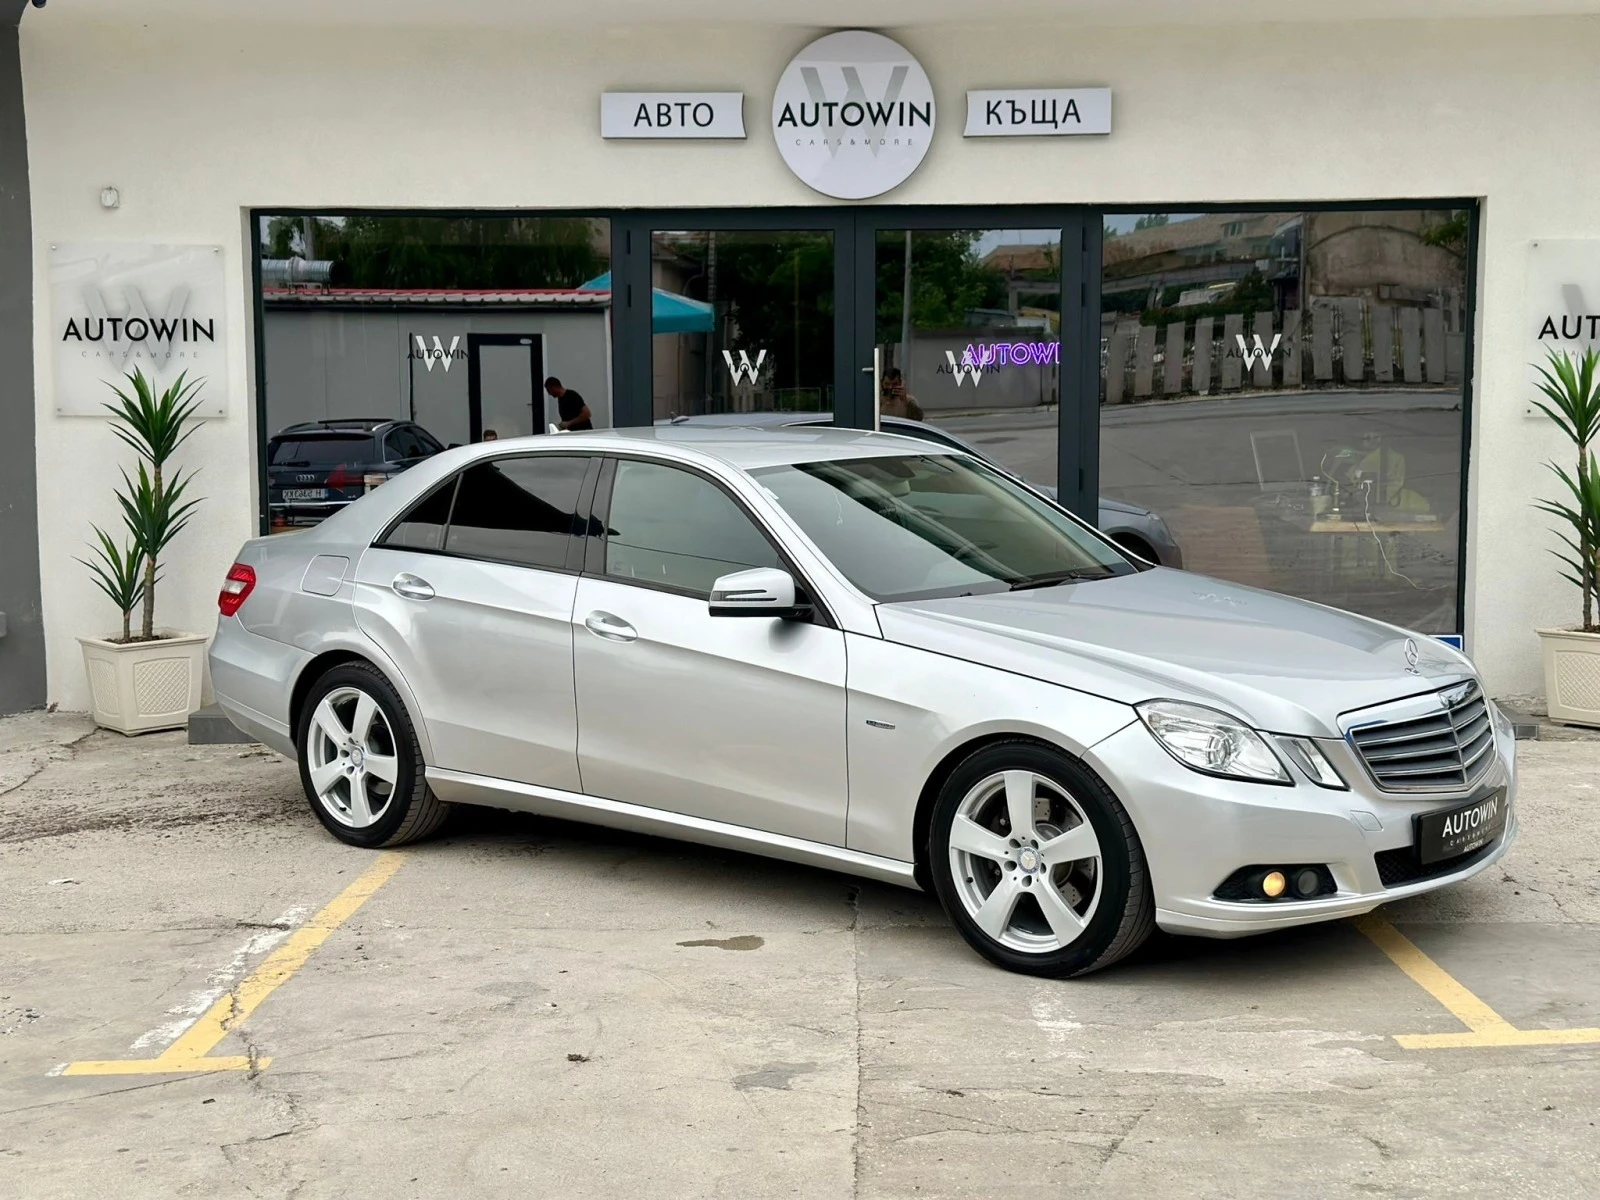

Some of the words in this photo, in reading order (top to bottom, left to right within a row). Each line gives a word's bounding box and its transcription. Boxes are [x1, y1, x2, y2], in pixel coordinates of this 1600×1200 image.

[633, 102, 714, 127] АВТО
[777, 101, 931, 127] AUTOWIN
[986, 99, 1081, 129] КЪЩА
[62, 317, 215, 342] AUTOWIN
[407, 348, 469, 360] AUTOWIN
[1225, 347, 1292, 359] AUTOWN
[722, 349, 767, 387] W
[936, 363, 1000, 374] AUTOWIN
[1441, 796, 1498, 838] AUTOWIN
